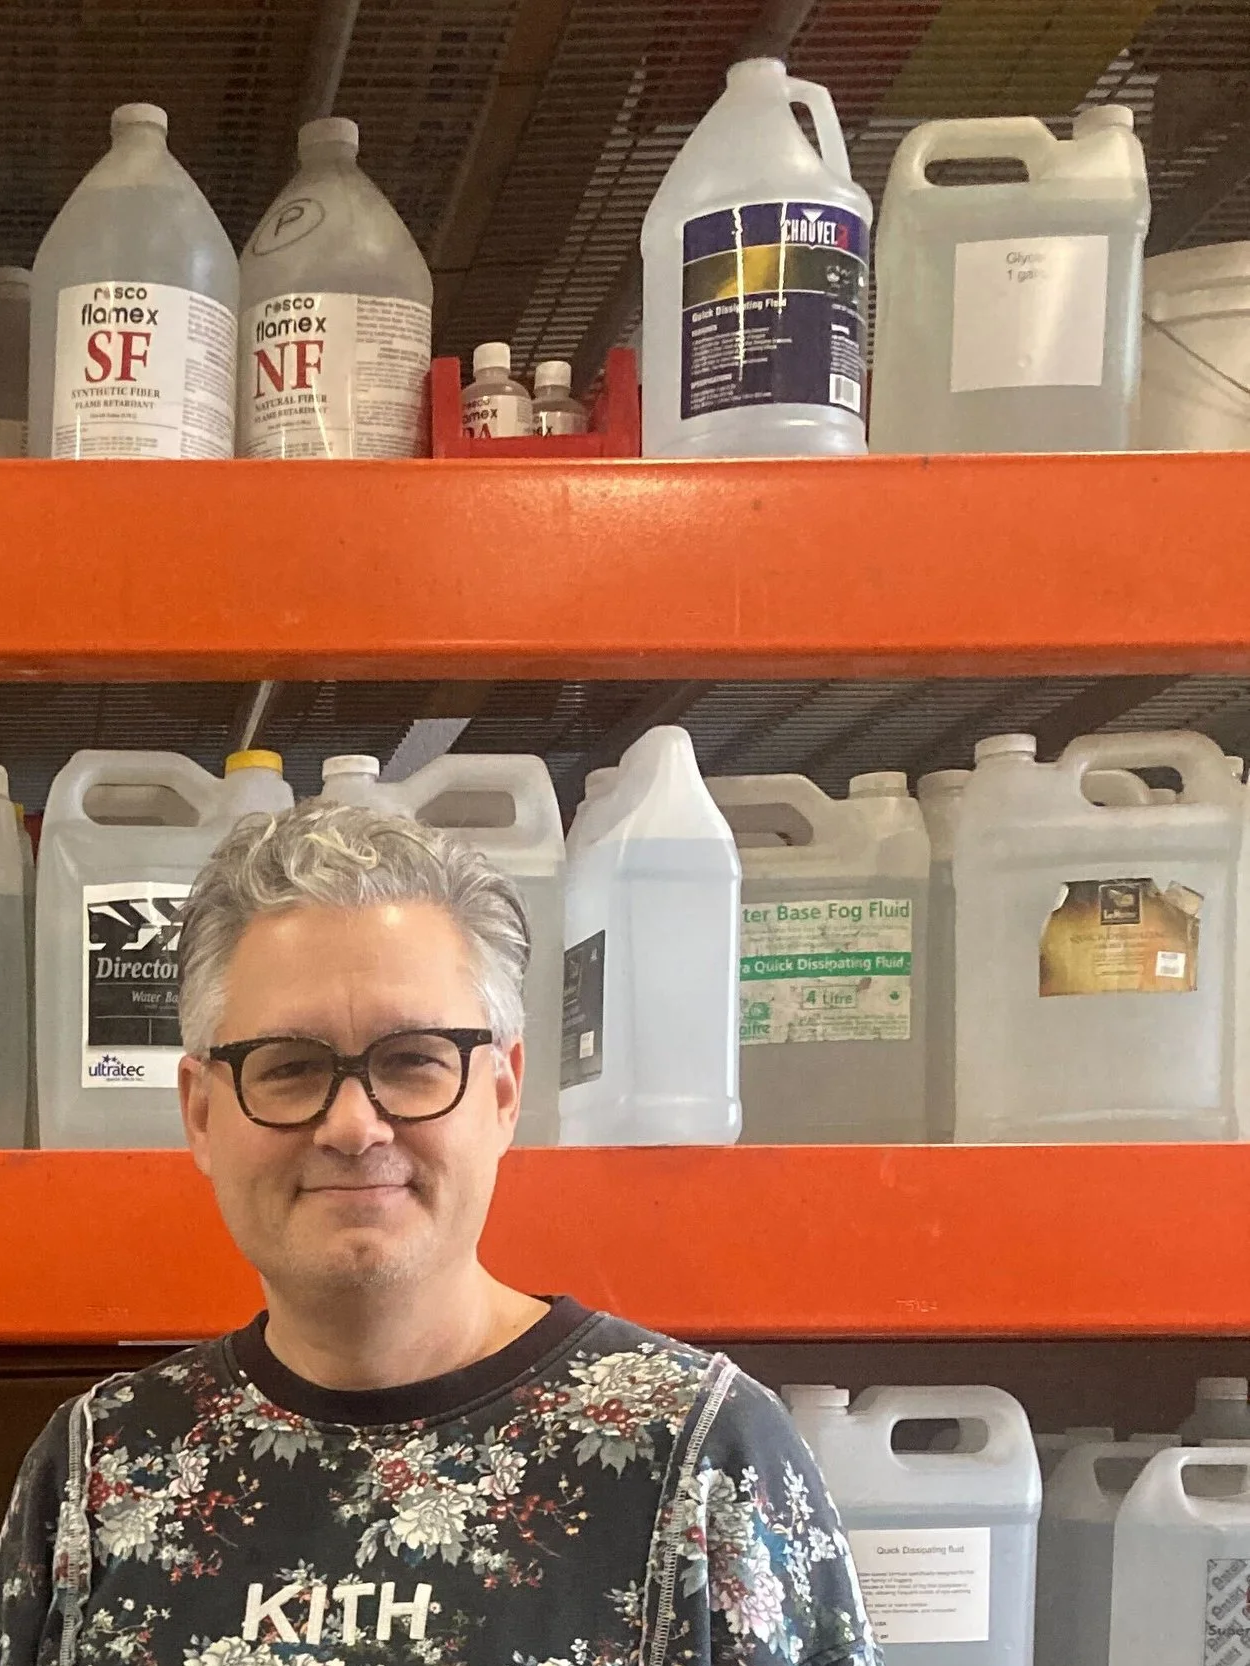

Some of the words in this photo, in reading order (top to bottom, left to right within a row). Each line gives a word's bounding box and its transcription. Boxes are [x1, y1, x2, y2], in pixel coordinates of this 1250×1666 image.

[274, 206, 304, 236] P
[784, 219, 838, 245] CHAUVET
[81, 303, 159, 326] flamex
[256, 315, 327, 344] flamex
[84, 330, 152, 383] SF
[253, 339, 324, 399] NF
[71, 387, 129, 399] SYNTHETIC
[130, 387, 161, 399] FIBER
[74, 400, 101, 410] FLAME
[102, 399, 155, 410] RETARDANT
[254, 396, 295, 413] NATURAL
[776, 904, 822, 921] Base
[828, 902, 863, 922] Fog
[868, 900, 910, 918] Fluid
[754, 959, 794, 973] Quick
[797, 957, 872, 972] Dissipating
[875, 955, 905, 969] Fluid
[131, 991, 163, 1003] Water
[806, 990, 817, 1005] 4
[822, 992, 854, 1005] Litre
[88, 1061, 146, 1077] ultratec
[876, 1546, 900, 1555] Quick
[901, 1545, 948, 1556] Dissipating
[242, 1580, 434, 1647] KITH
